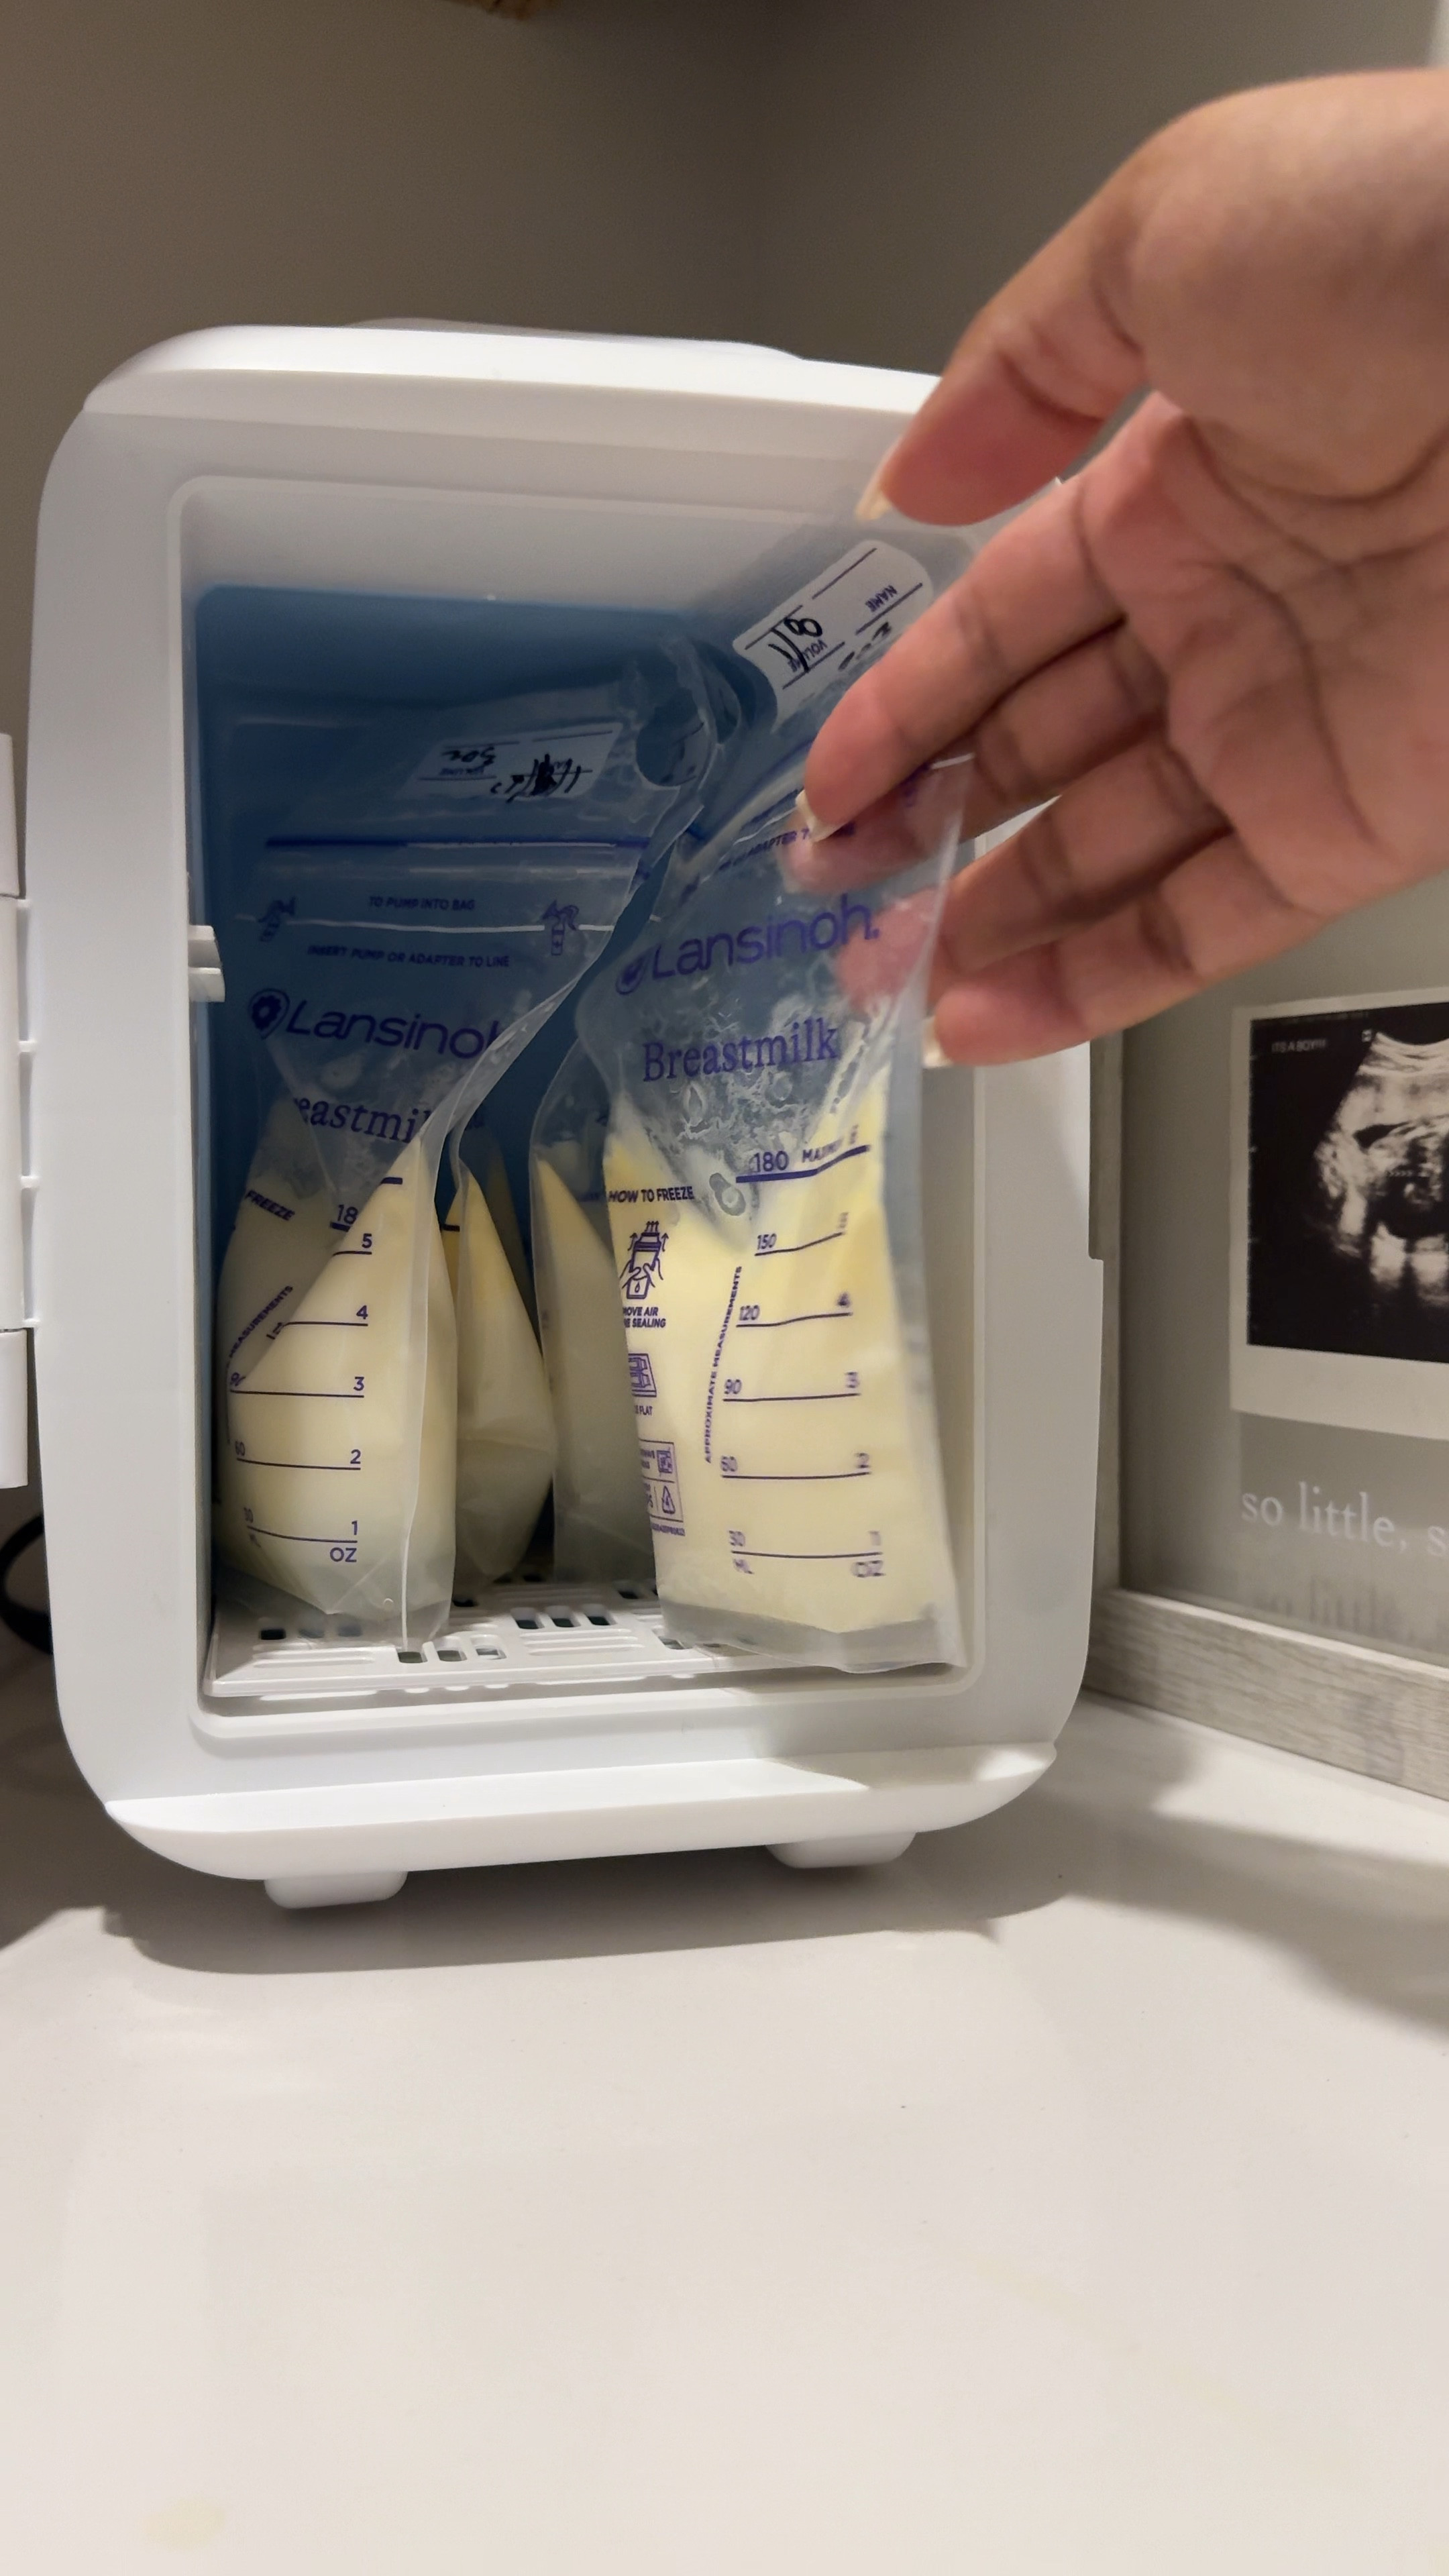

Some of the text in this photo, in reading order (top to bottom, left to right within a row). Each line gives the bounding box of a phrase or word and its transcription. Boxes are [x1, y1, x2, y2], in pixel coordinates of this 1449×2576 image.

[865, 585, 897, 612] NAME
[369, 896, 476, 911] TO PUMP INTO BAG
[651, 893, 874, 979] Lansinoh
[307, 945, 510, 968] INSERT PUMP OR ADAPTER TO LINE
[642, 1017, 839, 1083] Breastmilk
[753, 1150, 789, 1173] 180
[608, 1189, 638, 1203] HOW
[641, 1189, 655, 1202] TO
[656, 1185, 695, 1201] FREEZE
[245, 1189, 295, 1221] FREEZE
[337, 1204, 360, 1225] 18
[362, 1233, 372, 1249] 5
[757, 1233, 777, 1250] 150
[356, 1305, 368, 1320] 4
[644, 1306, 659, 1316] AIR
[739, 1305, 760, 1321] 120
[633, 1318, 666, 1328] SEALING
[354, 1376, 365, 1391] 3
[350, 1449, 362, 1465] 2
[1241, 1493, 1284, 1527] so
[1299, 1480, 1407, 1553] little,
[351, 1520, 358, 1536] 1
[329, 1547, 358, 1563] OZ
[850, 1560, 886, 1578] OZ
